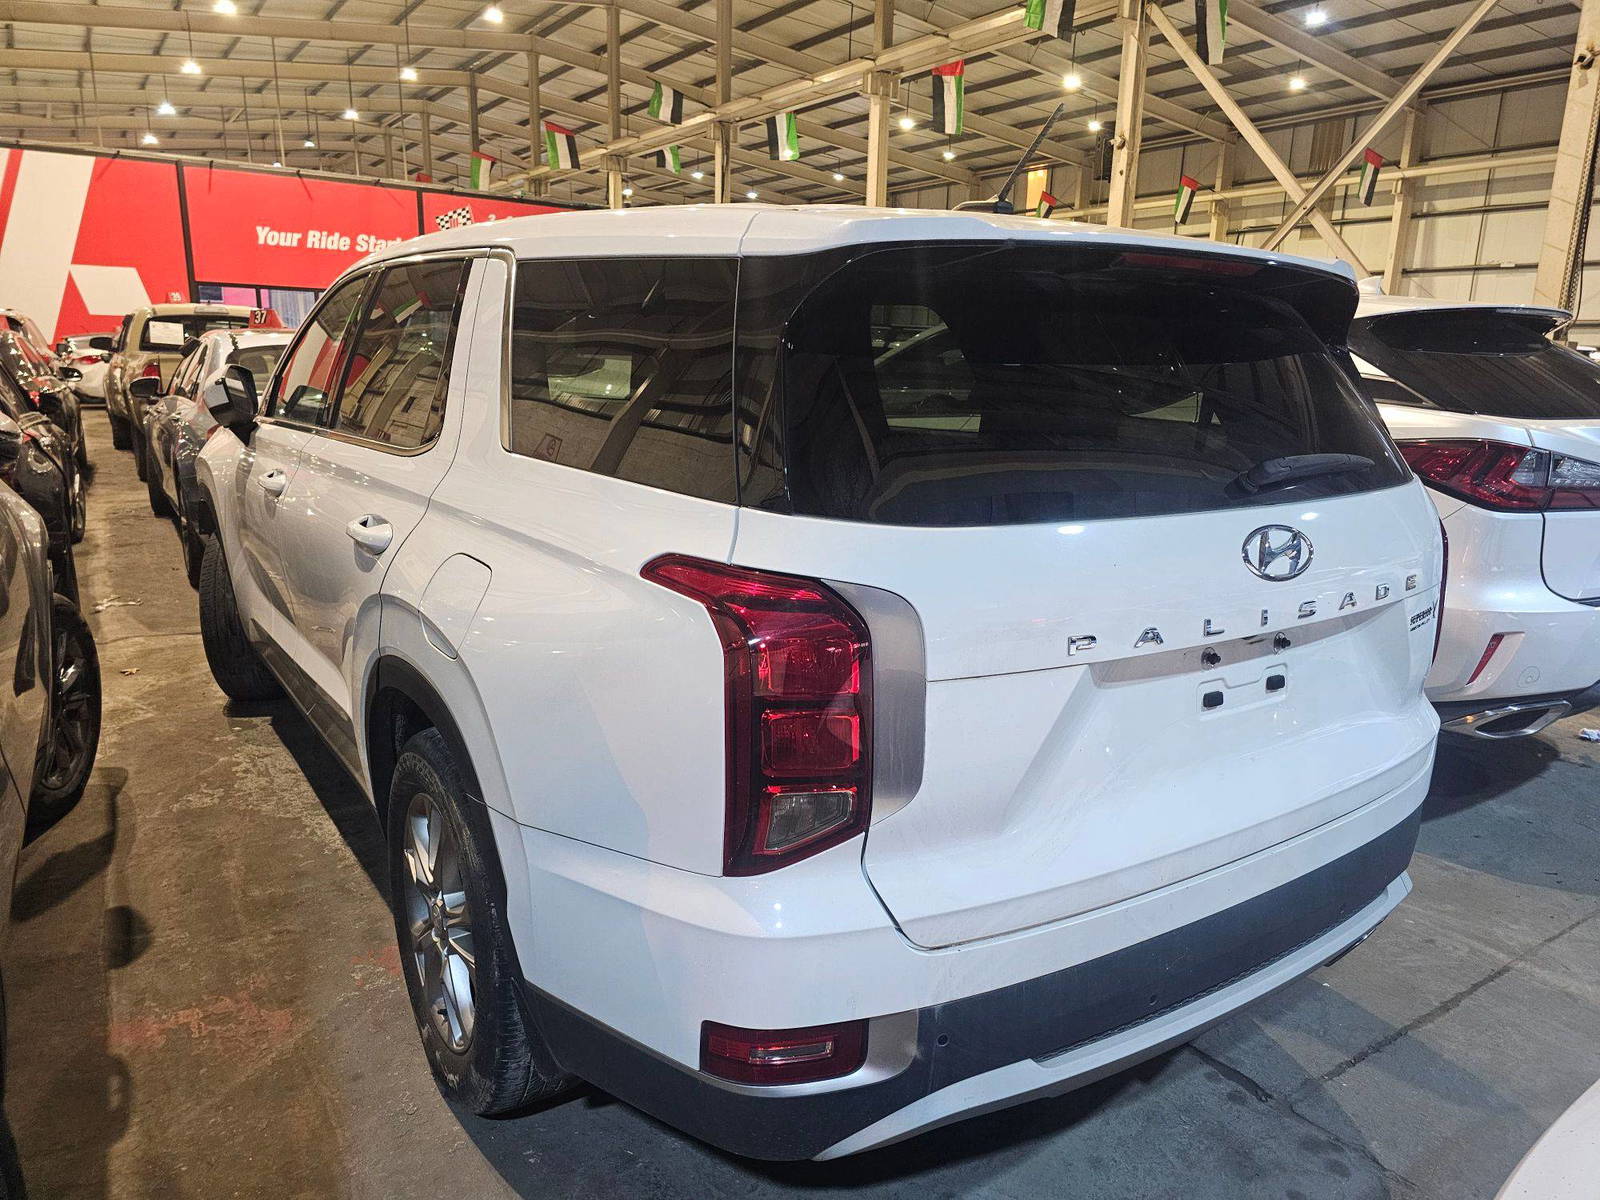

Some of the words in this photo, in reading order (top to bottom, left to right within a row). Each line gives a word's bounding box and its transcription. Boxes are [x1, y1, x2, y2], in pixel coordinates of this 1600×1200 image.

[256, 226, 302, 247] Your
[306, 230, 351, 251] Ride
[254, 310, 267, 324] 37
[1067, 574, 1417, 656] PALISADE
